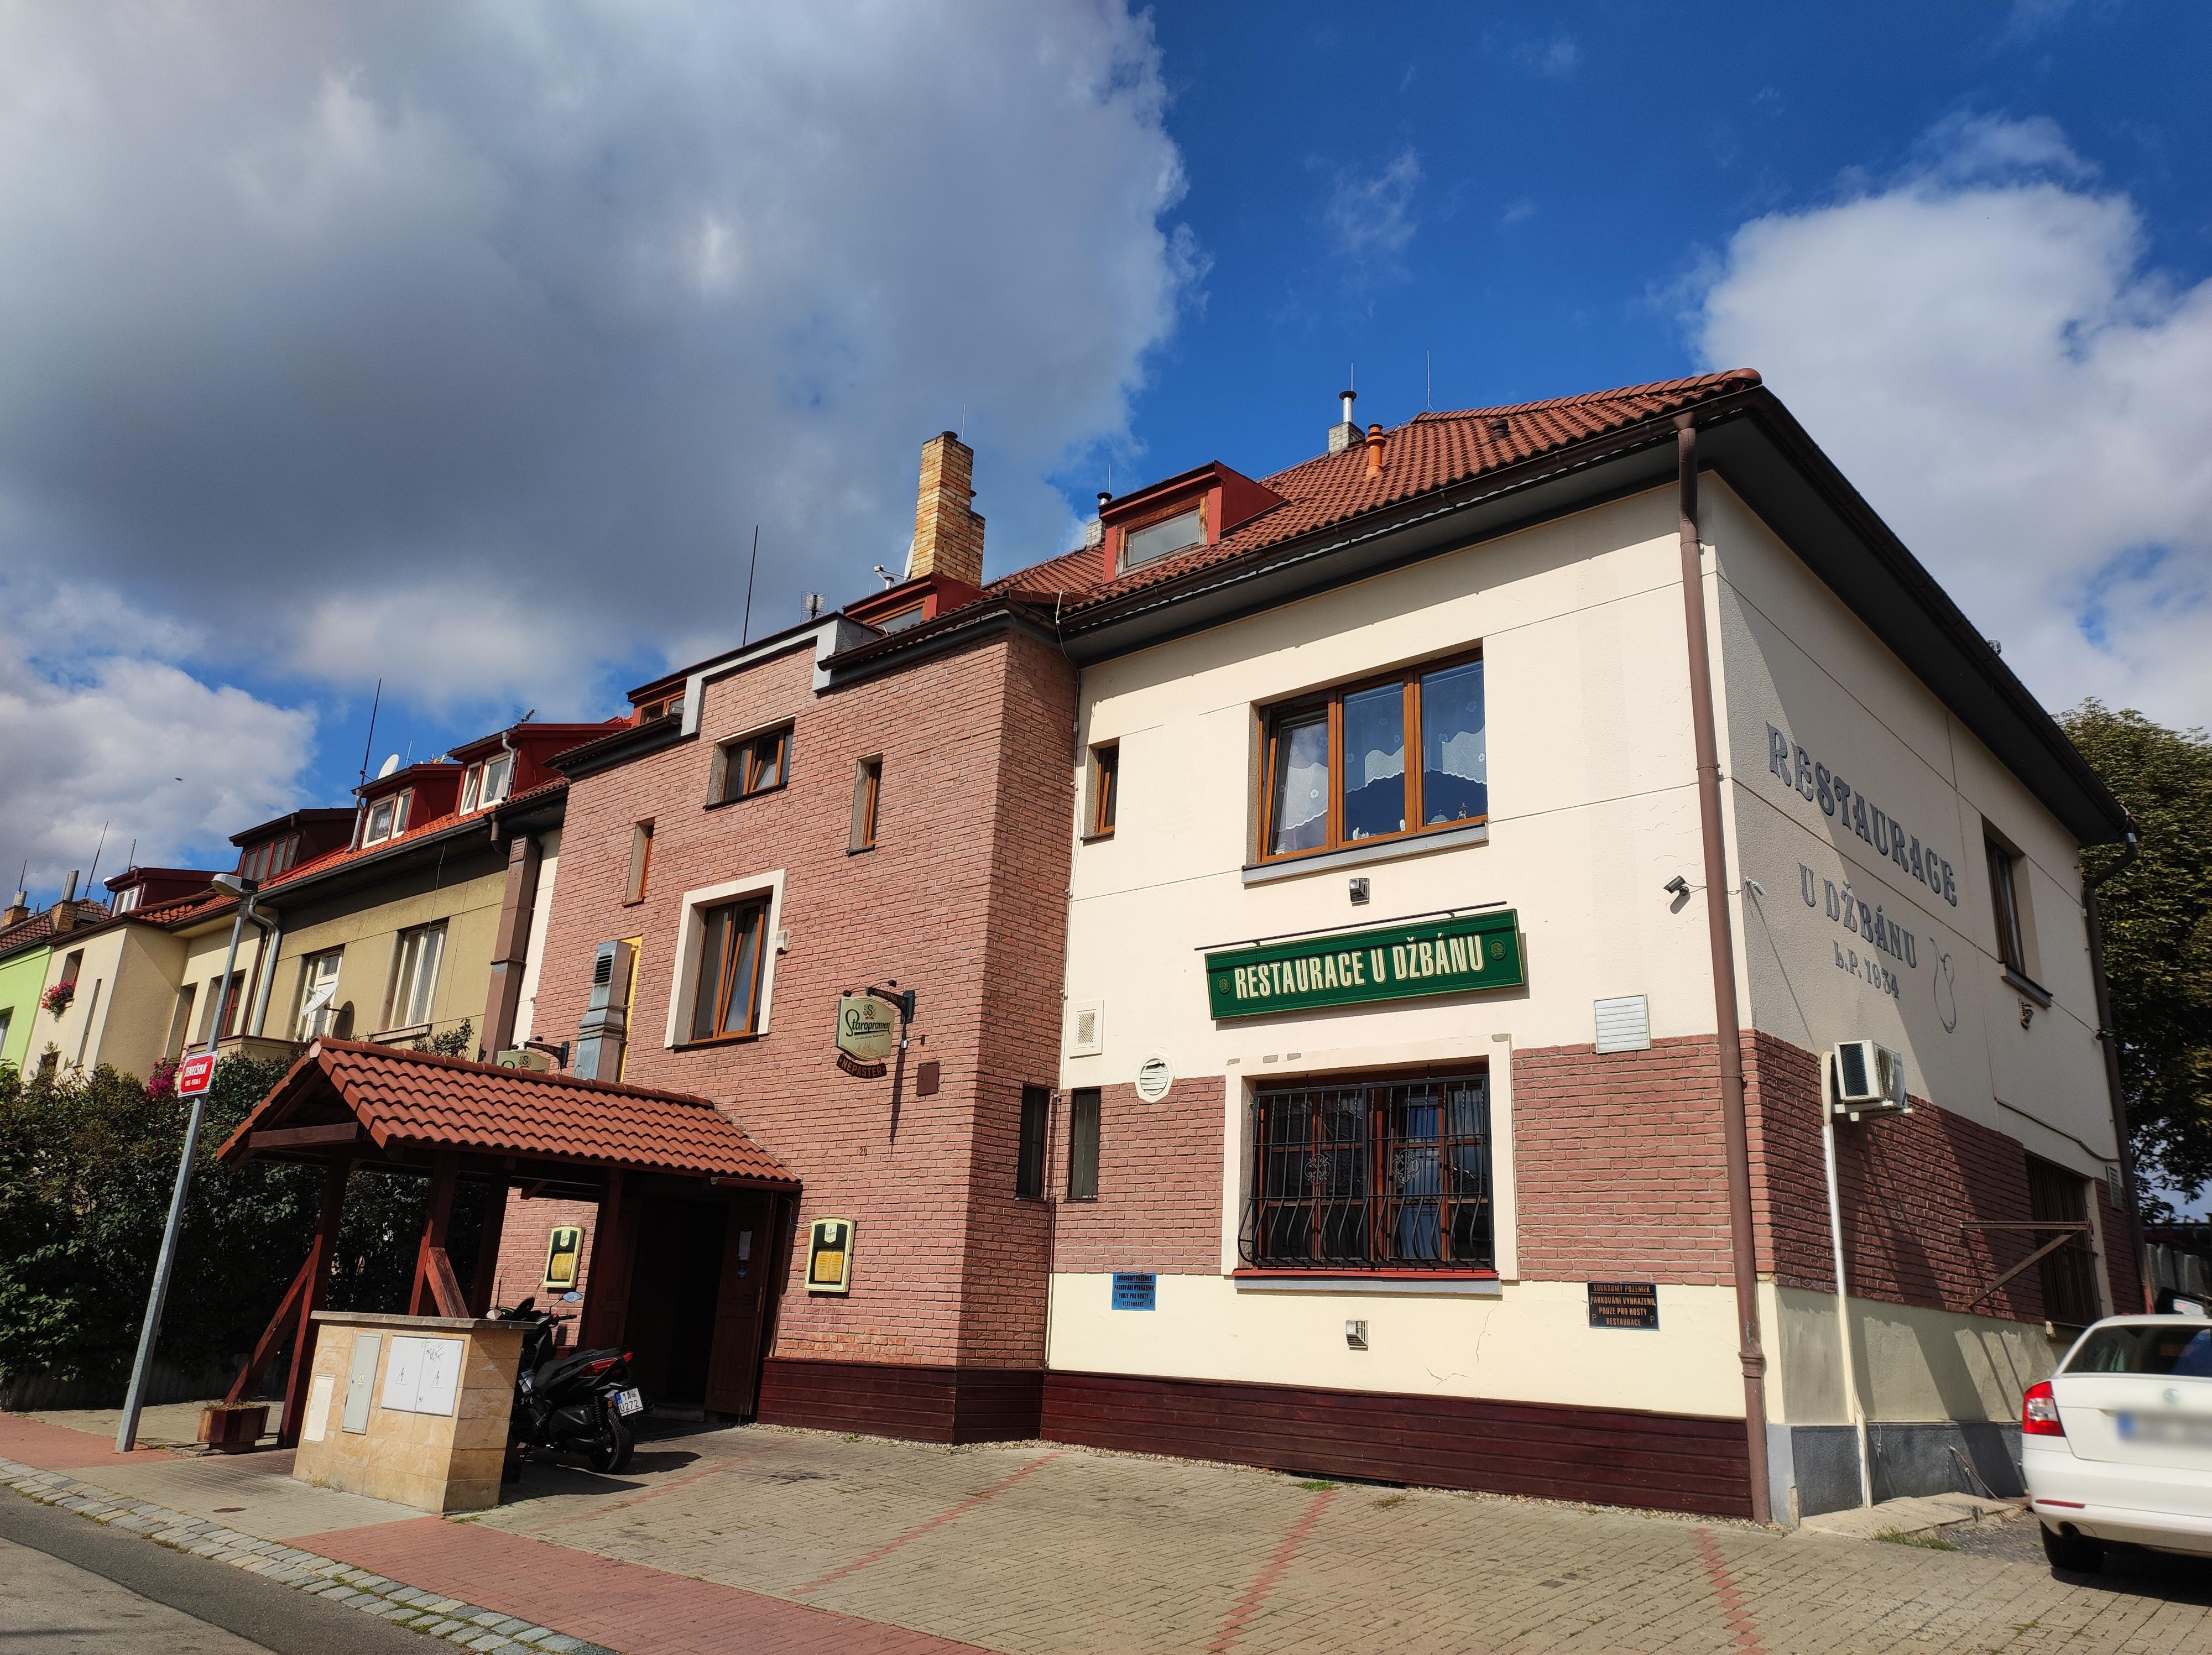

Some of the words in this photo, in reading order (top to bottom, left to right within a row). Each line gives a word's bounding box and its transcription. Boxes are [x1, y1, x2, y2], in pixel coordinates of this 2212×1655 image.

[1766, 720, 1957, 907] RESTAURACE
[1798, 862, 1816, 907] U
[1823, 877, 1917, 968] DŽBÁNU
[1234, 951, 1366, 1000] RESTAURACE
[1370, 948, 1386, 983] U
[1392, 932, 1485, 982] DŽBÁNU
[1864, 957, 1900, 1000] 1934
[875, 989, 898, 1002] TANKOVNA
[845, 1009, 891, 1037] Staropramen
[841, 1058, 883, 1077] NEPASTER
[1590, 1296, 1621, 1304] PARKOVÁNÍ
[1599, 1307, 1615, 1315] POUZE
[1606, 1318, 1641, 1326] RESTAURACE
[623, 1391, 632, 1401] 1A
[619, 1400, 639, 1412] U272
